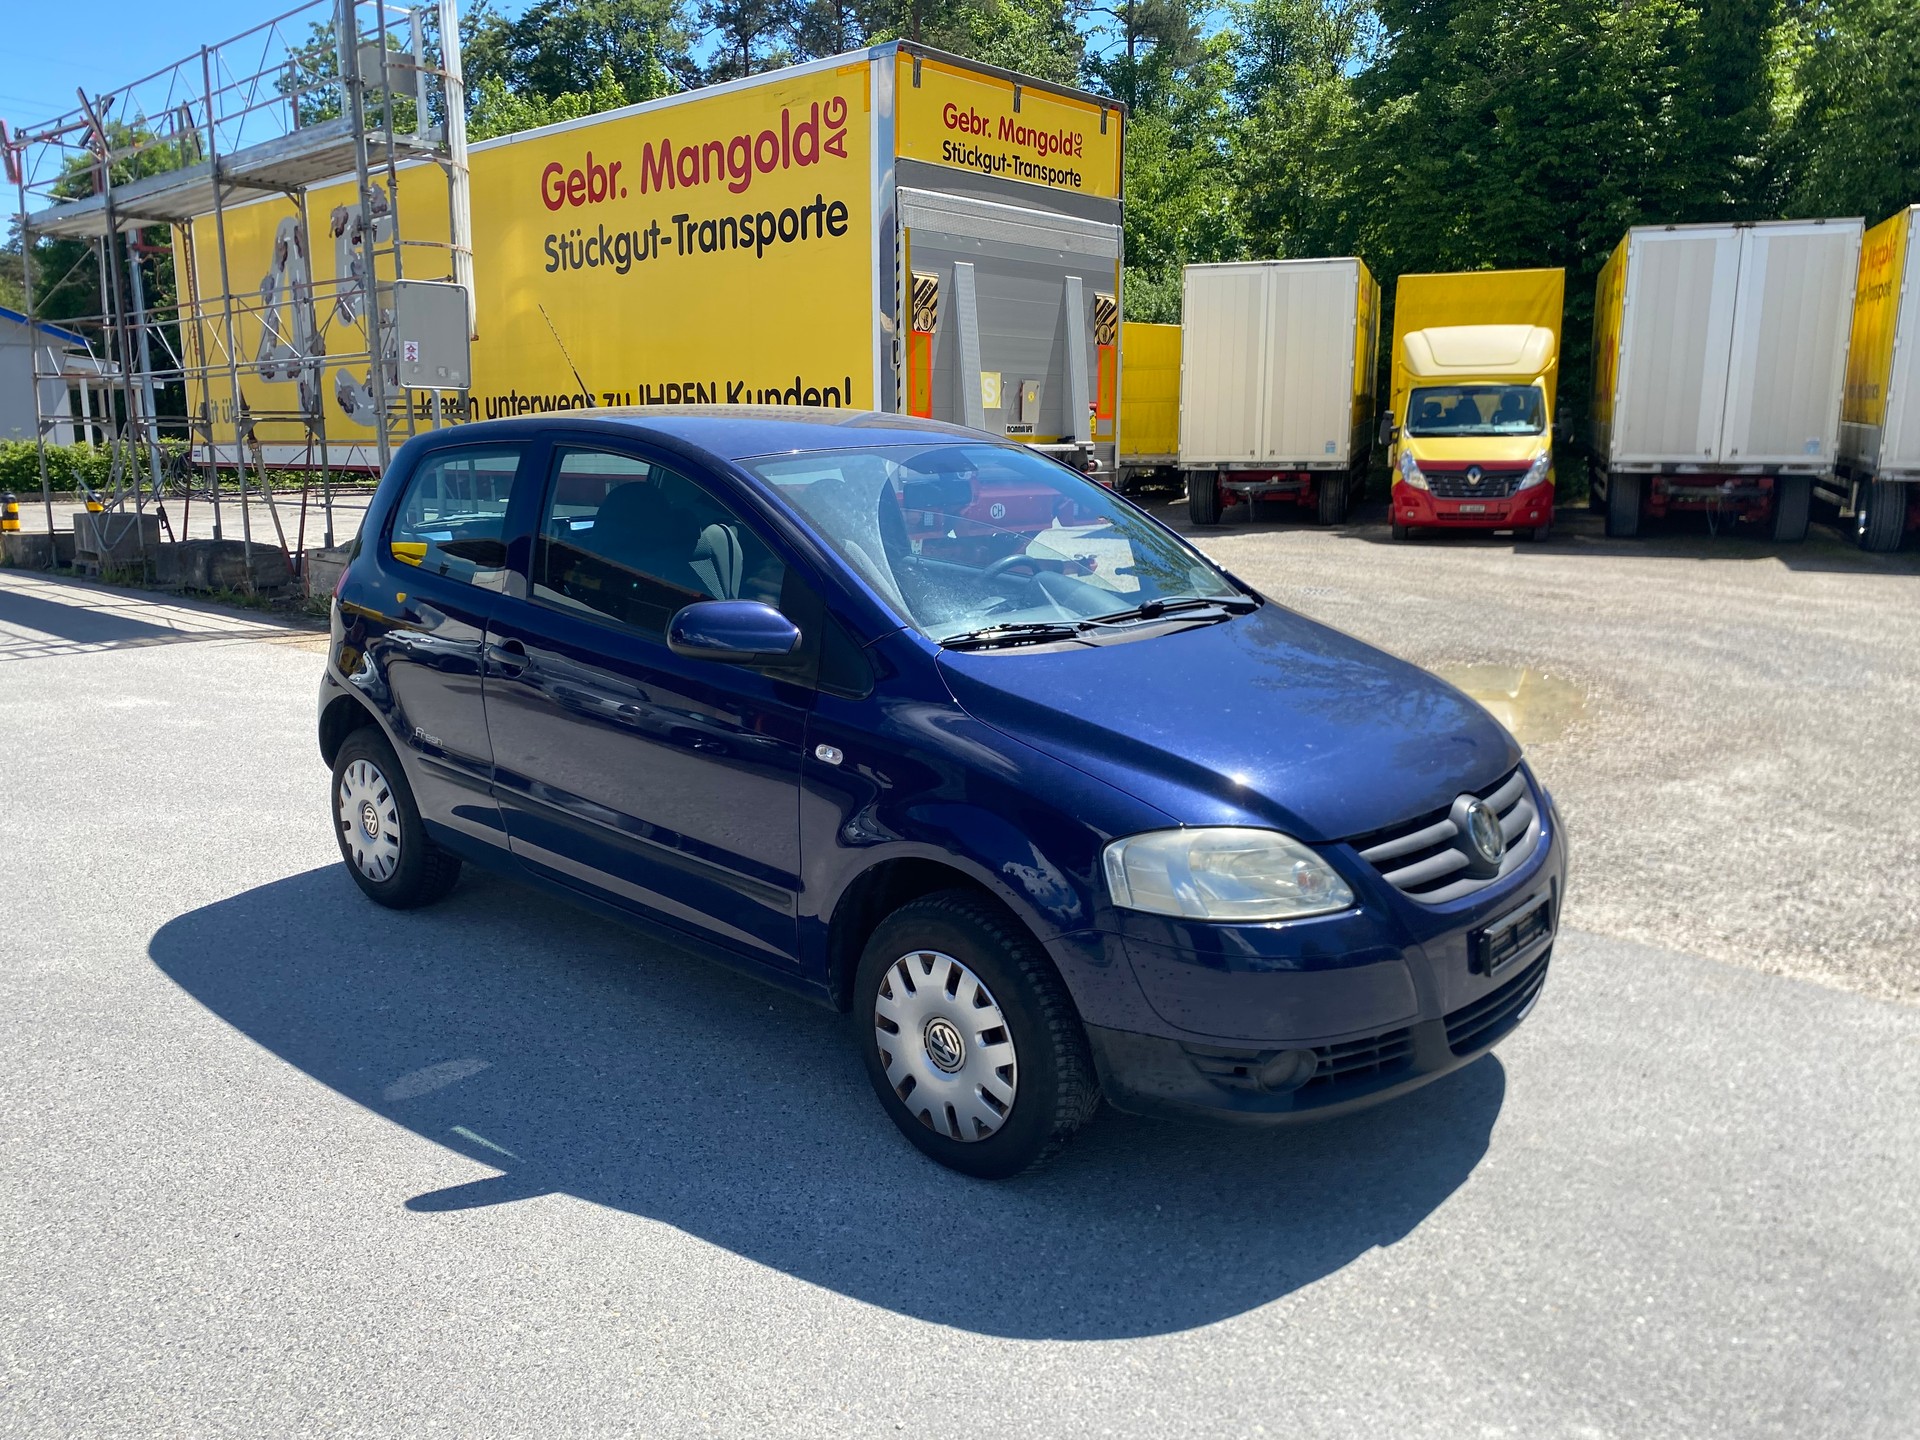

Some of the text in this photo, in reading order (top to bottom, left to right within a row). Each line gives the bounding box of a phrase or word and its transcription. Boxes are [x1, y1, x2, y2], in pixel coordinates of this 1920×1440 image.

[942, 102, 1083, 158] Gebr. Mangold AG
[541, 96, 847, 211] Gebr. Mangold AG
[942, 139, 1082, 187] Stückgut-Transporte
[544, 193, 848, 275] Stückgut-Transporte
[726, 375, 851, 408] Kunden!
[983, 377, 995, 403] S
[992, 505, 1003, 518] CH
[415, 726, 443, 746] Fresh
